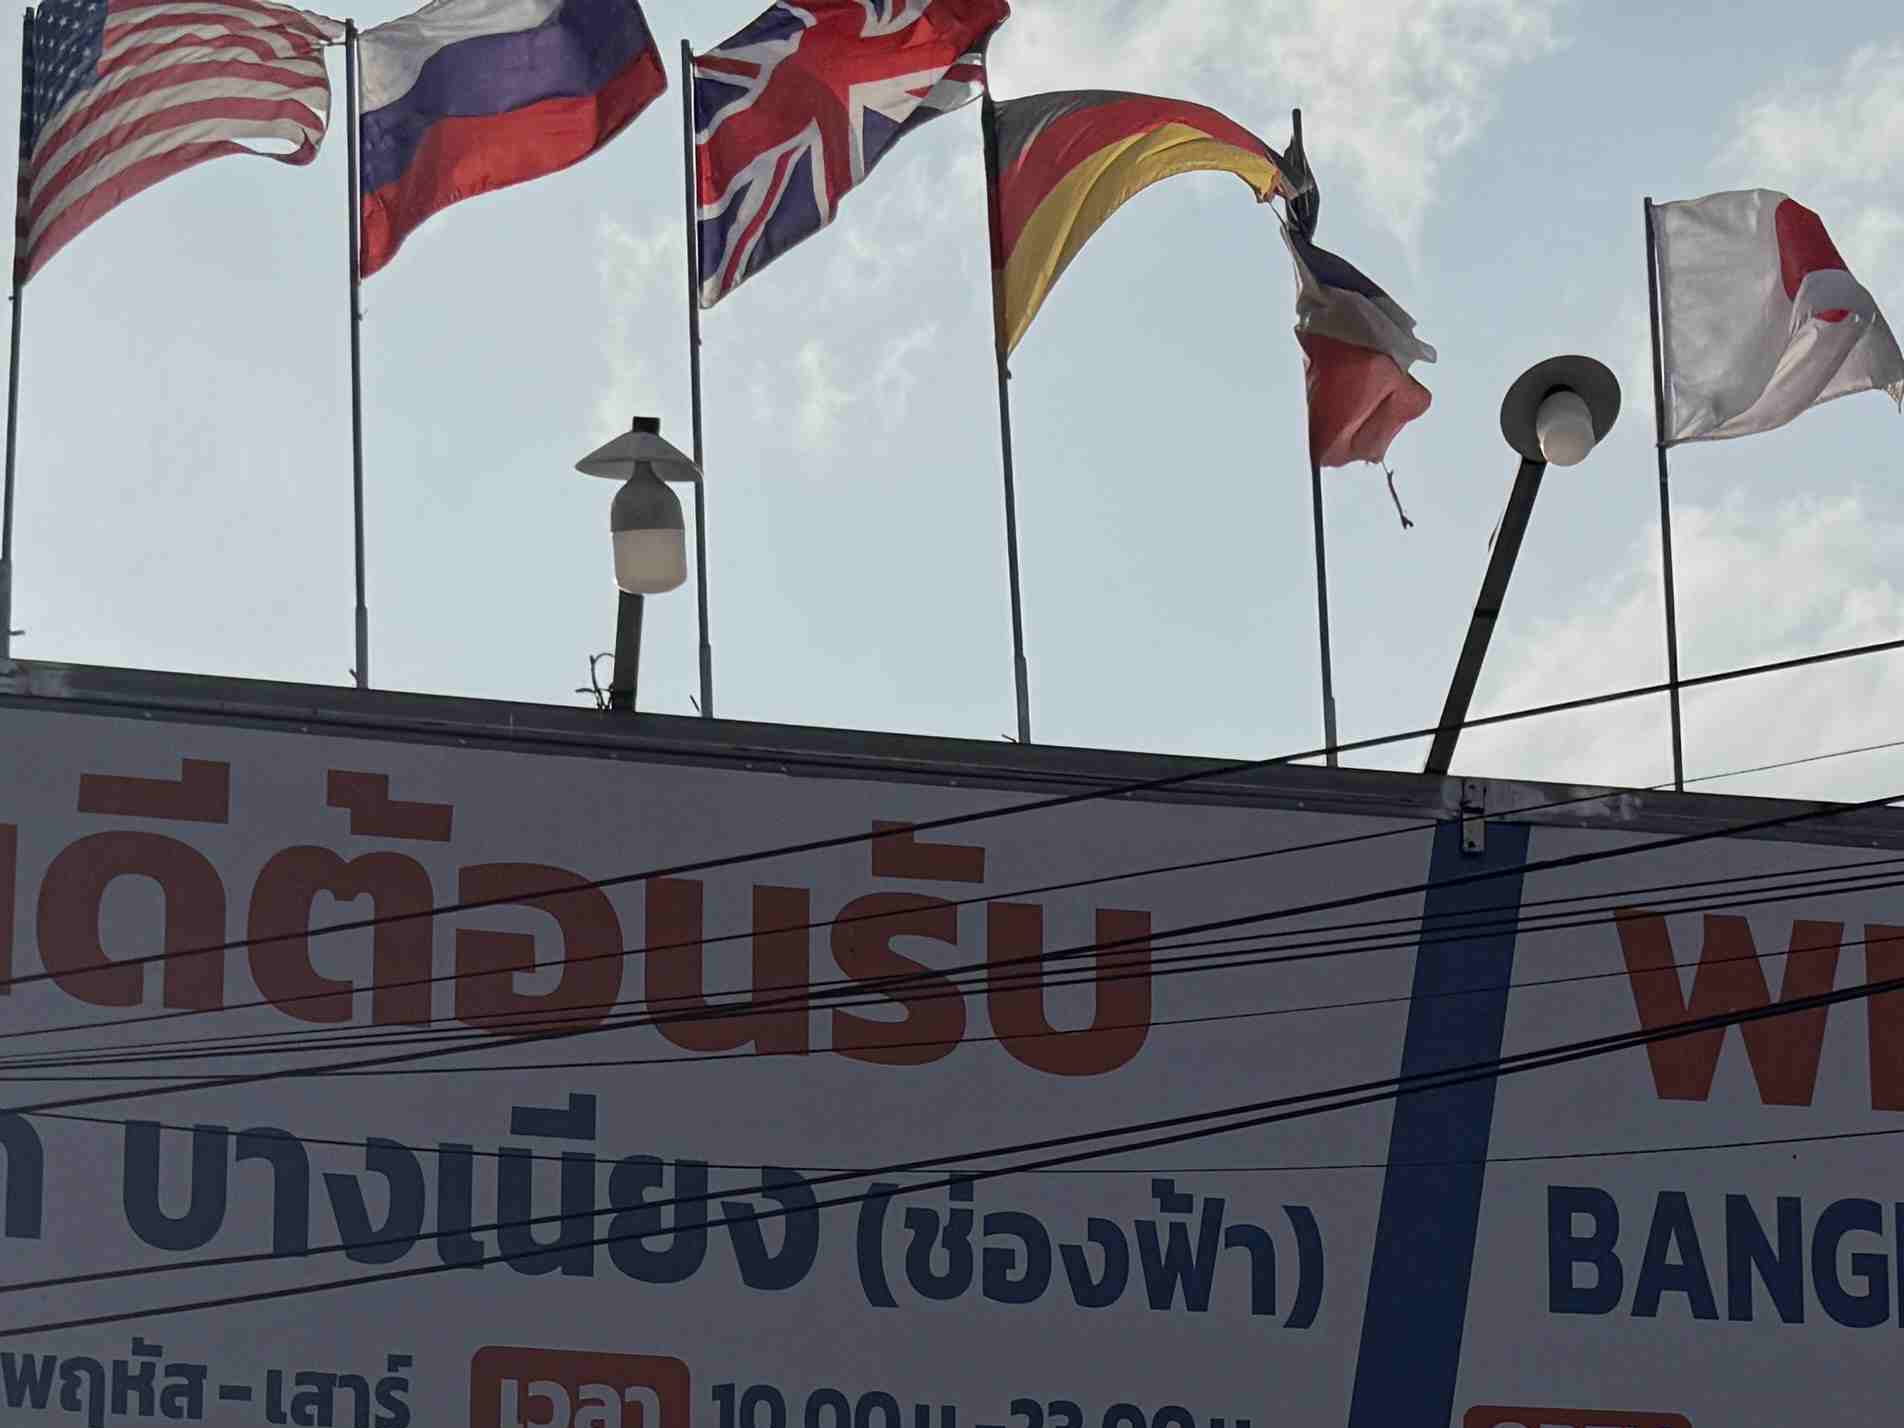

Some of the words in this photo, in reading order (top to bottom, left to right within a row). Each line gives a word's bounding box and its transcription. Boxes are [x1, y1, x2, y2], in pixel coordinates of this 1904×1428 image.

[122, 1093, 820, 1292] บางเนียง
[856, 1174, 1326, 1330] (ช่องฟ้า)
